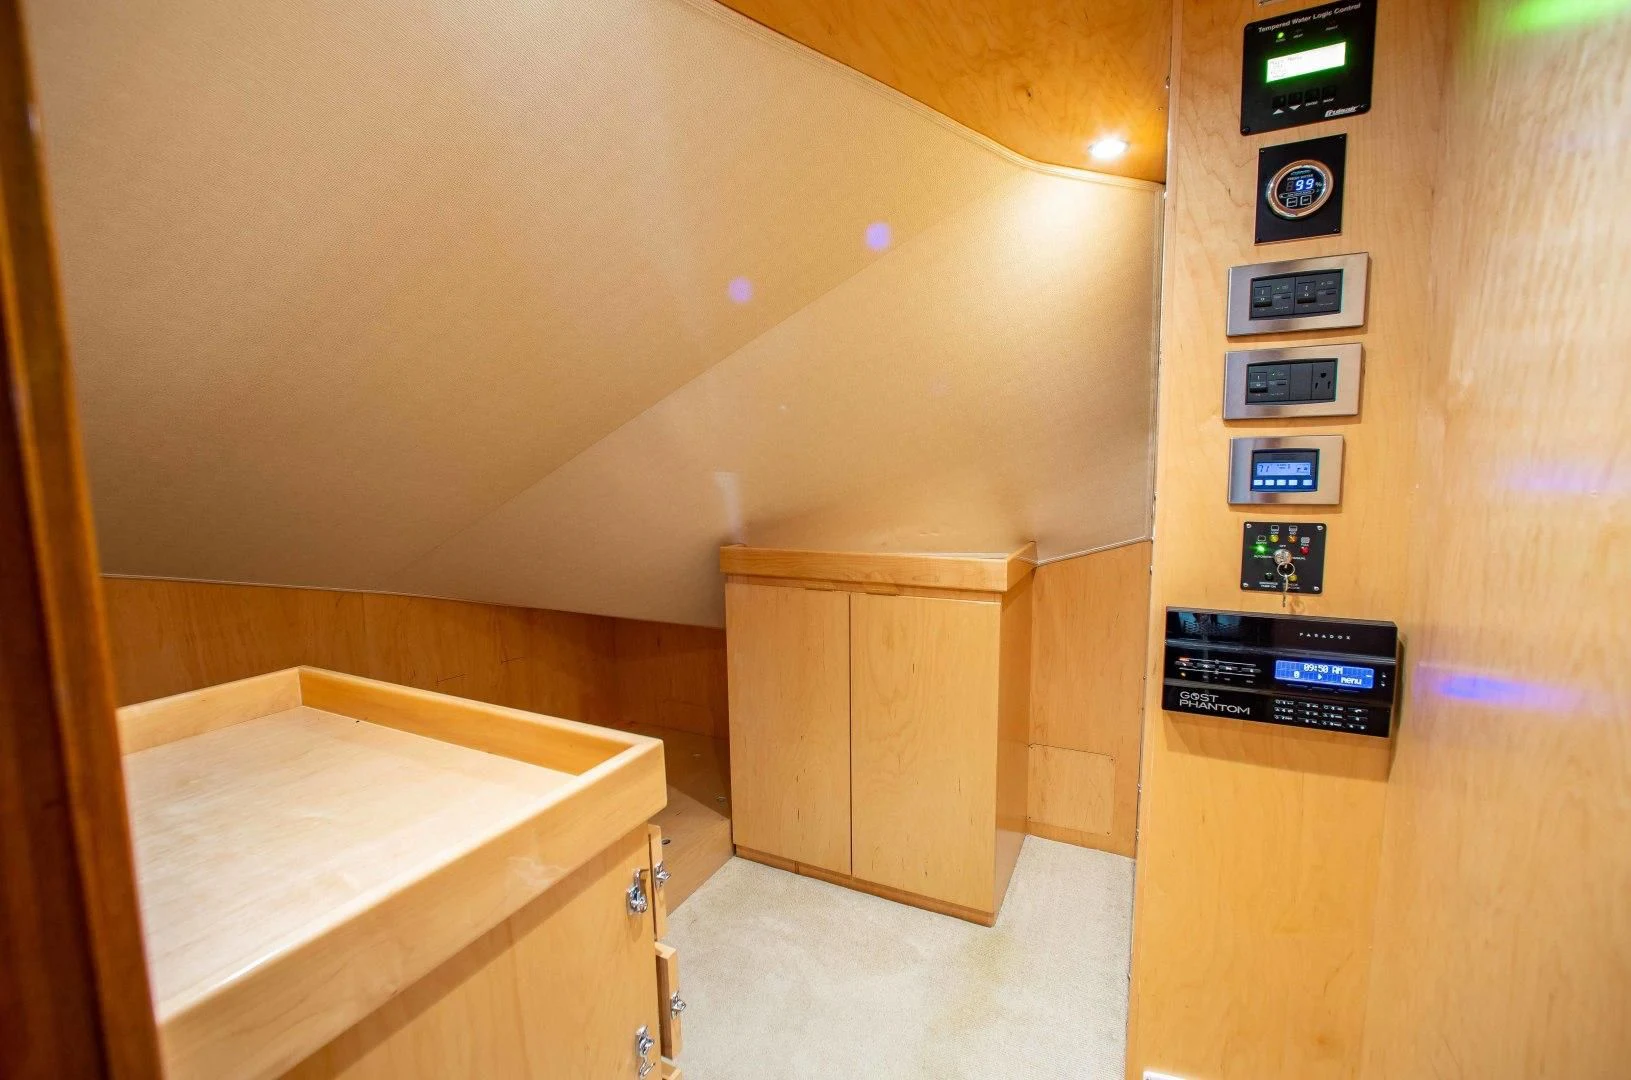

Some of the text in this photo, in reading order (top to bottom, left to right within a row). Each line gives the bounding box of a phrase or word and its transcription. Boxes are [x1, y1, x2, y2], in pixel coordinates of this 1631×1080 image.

[1258, 3, 1361, 33] Tempered Water Logic Control
[1296, 179, 1314, 190] 99
[1299, 632, 1351, 641] PARADOX
[1303, 664, 1343, 675] 09:50 AM
[1340, 676, 1362, 686] menu
[1179, 691, 1219, 703] GOST
[1179, 700, 1251, 715] PHANTOM
